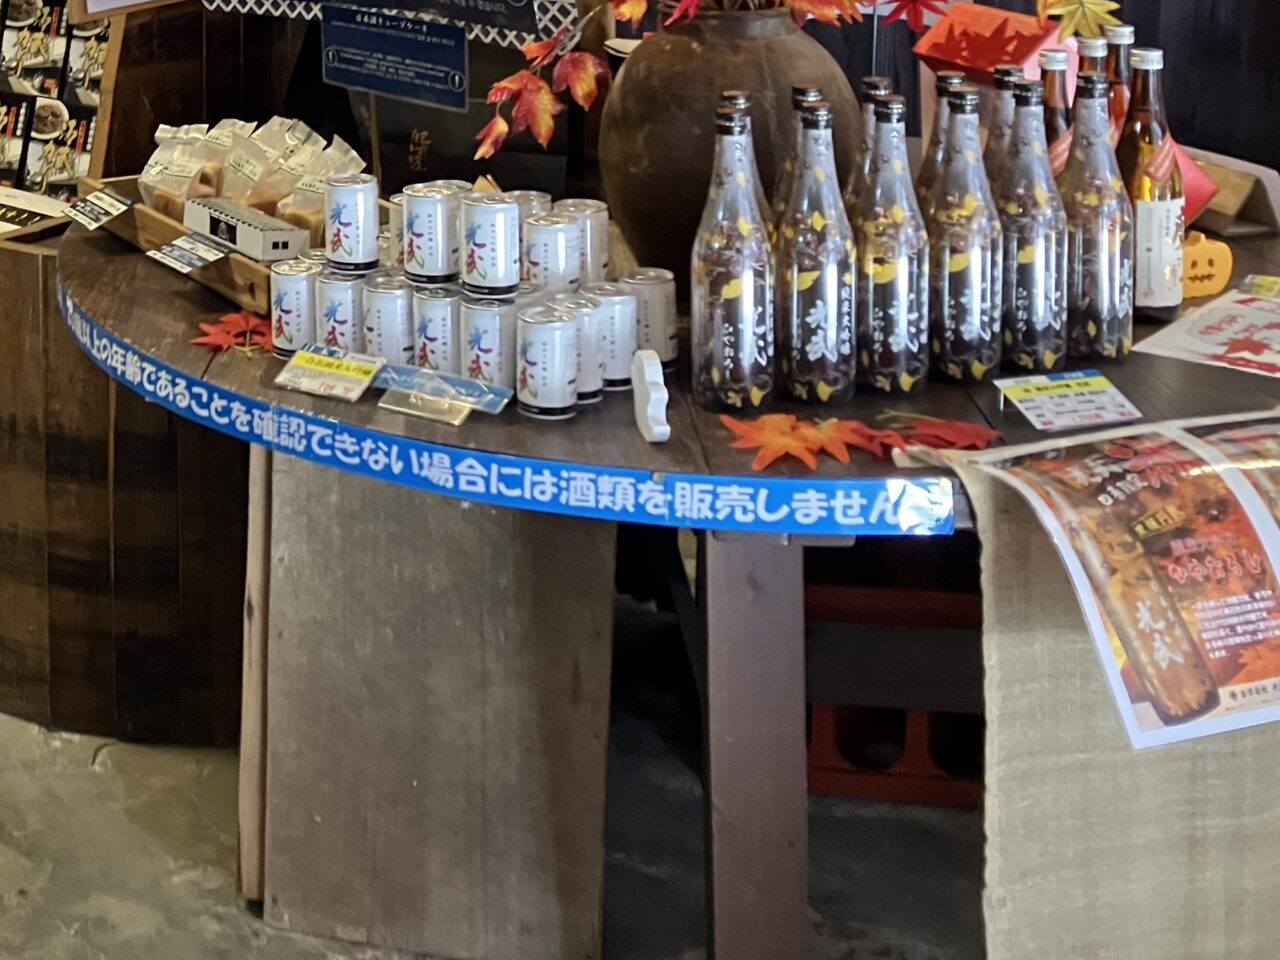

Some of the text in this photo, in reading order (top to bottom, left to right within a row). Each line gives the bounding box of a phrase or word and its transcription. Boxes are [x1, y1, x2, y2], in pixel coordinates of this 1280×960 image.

[329, 201, 354, 258] 光武
[405, 213, 425, 270] 光武
[464, 222, 488, 281] 光武
[273, 290, 294, 345] 光武
[416, 317, 441, 371] 光武
[804, 298, 840, 364] 光武
[468, 325, 494, 384] 光武
